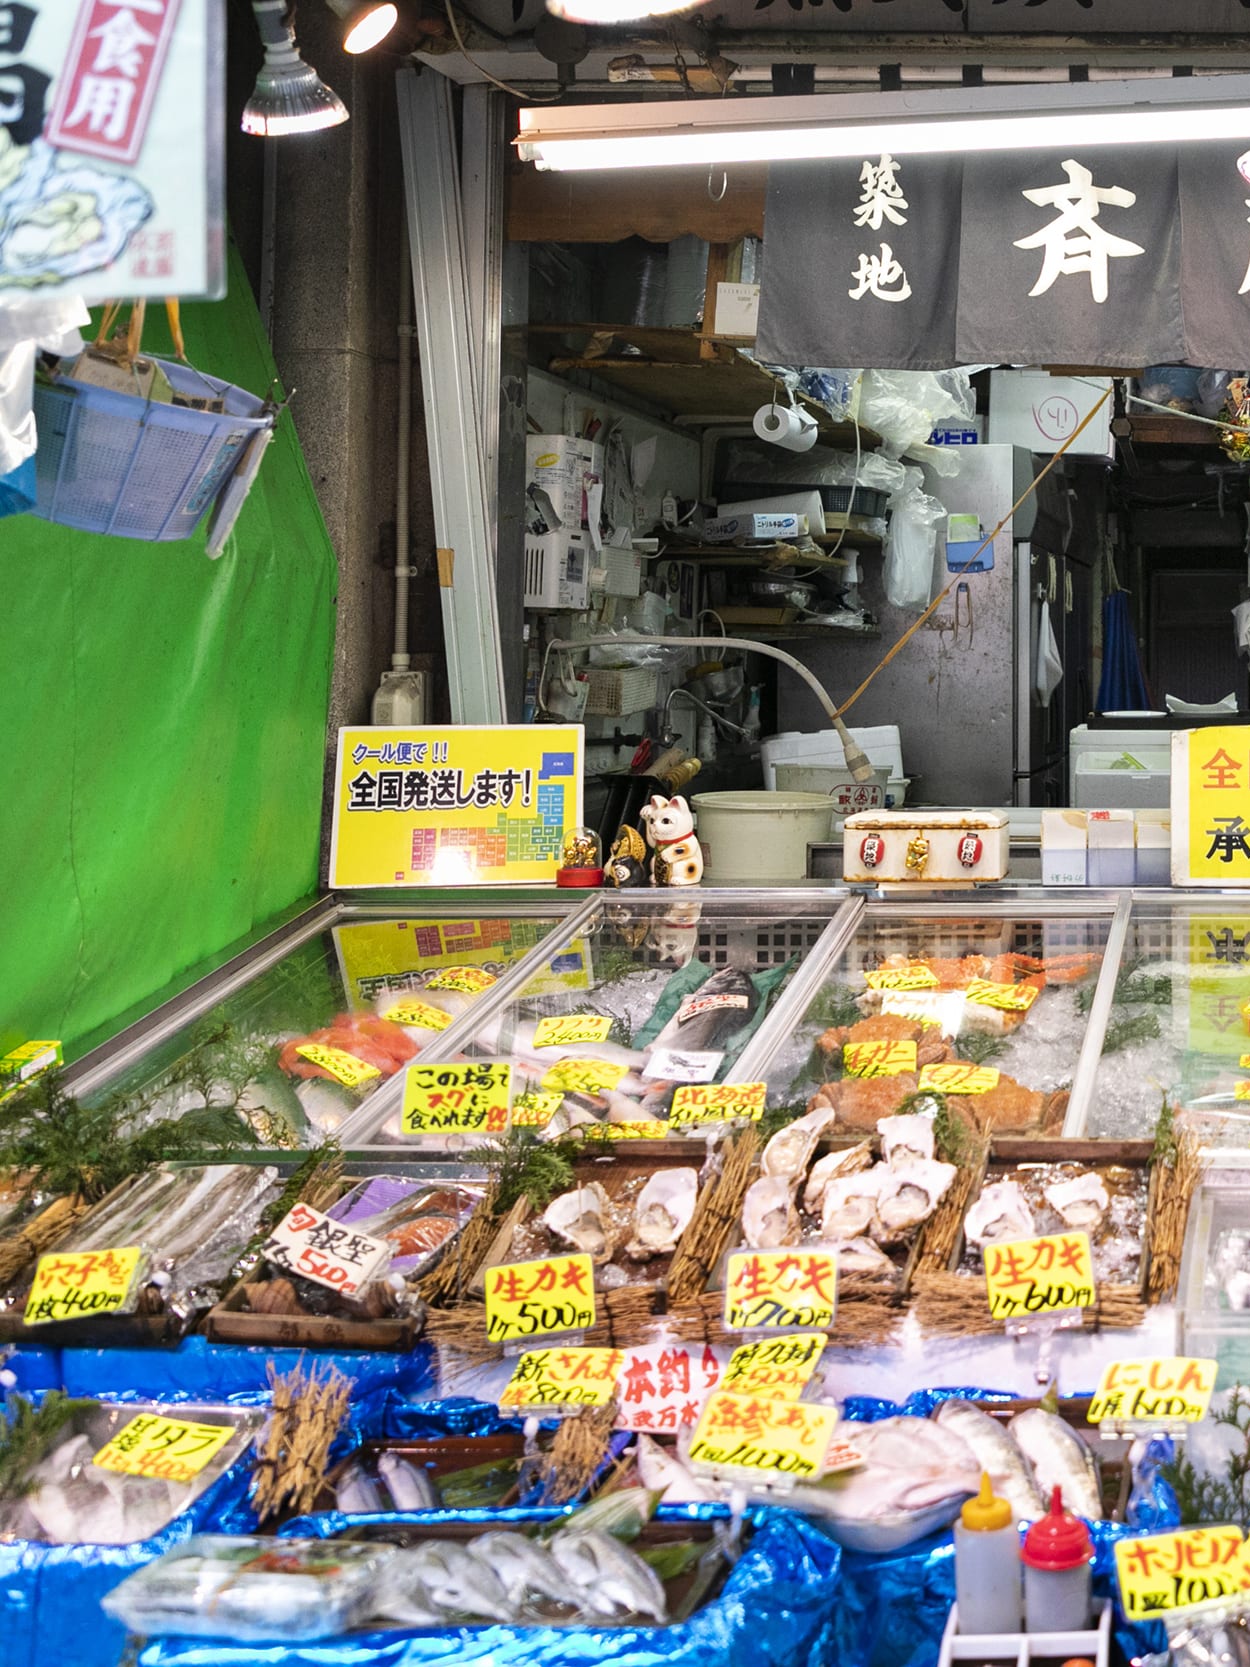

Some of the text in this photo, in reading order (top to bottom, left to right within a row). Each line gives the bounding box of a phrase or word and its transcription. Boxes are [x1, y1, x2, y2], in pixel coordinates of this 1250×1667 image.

[848, 152, 912, 303] 築地
[350, 769, 531, 808] 全国発送します!
[427, 1086, 489, 1108] スグに
[492, 1263, 587, 1303] 生カキ
[732, 1253, 833, 1305] 生カキ
[990, 1238, 1084, 1288] 生カキ
[1104, 1361, 1208, 1393] にしん
